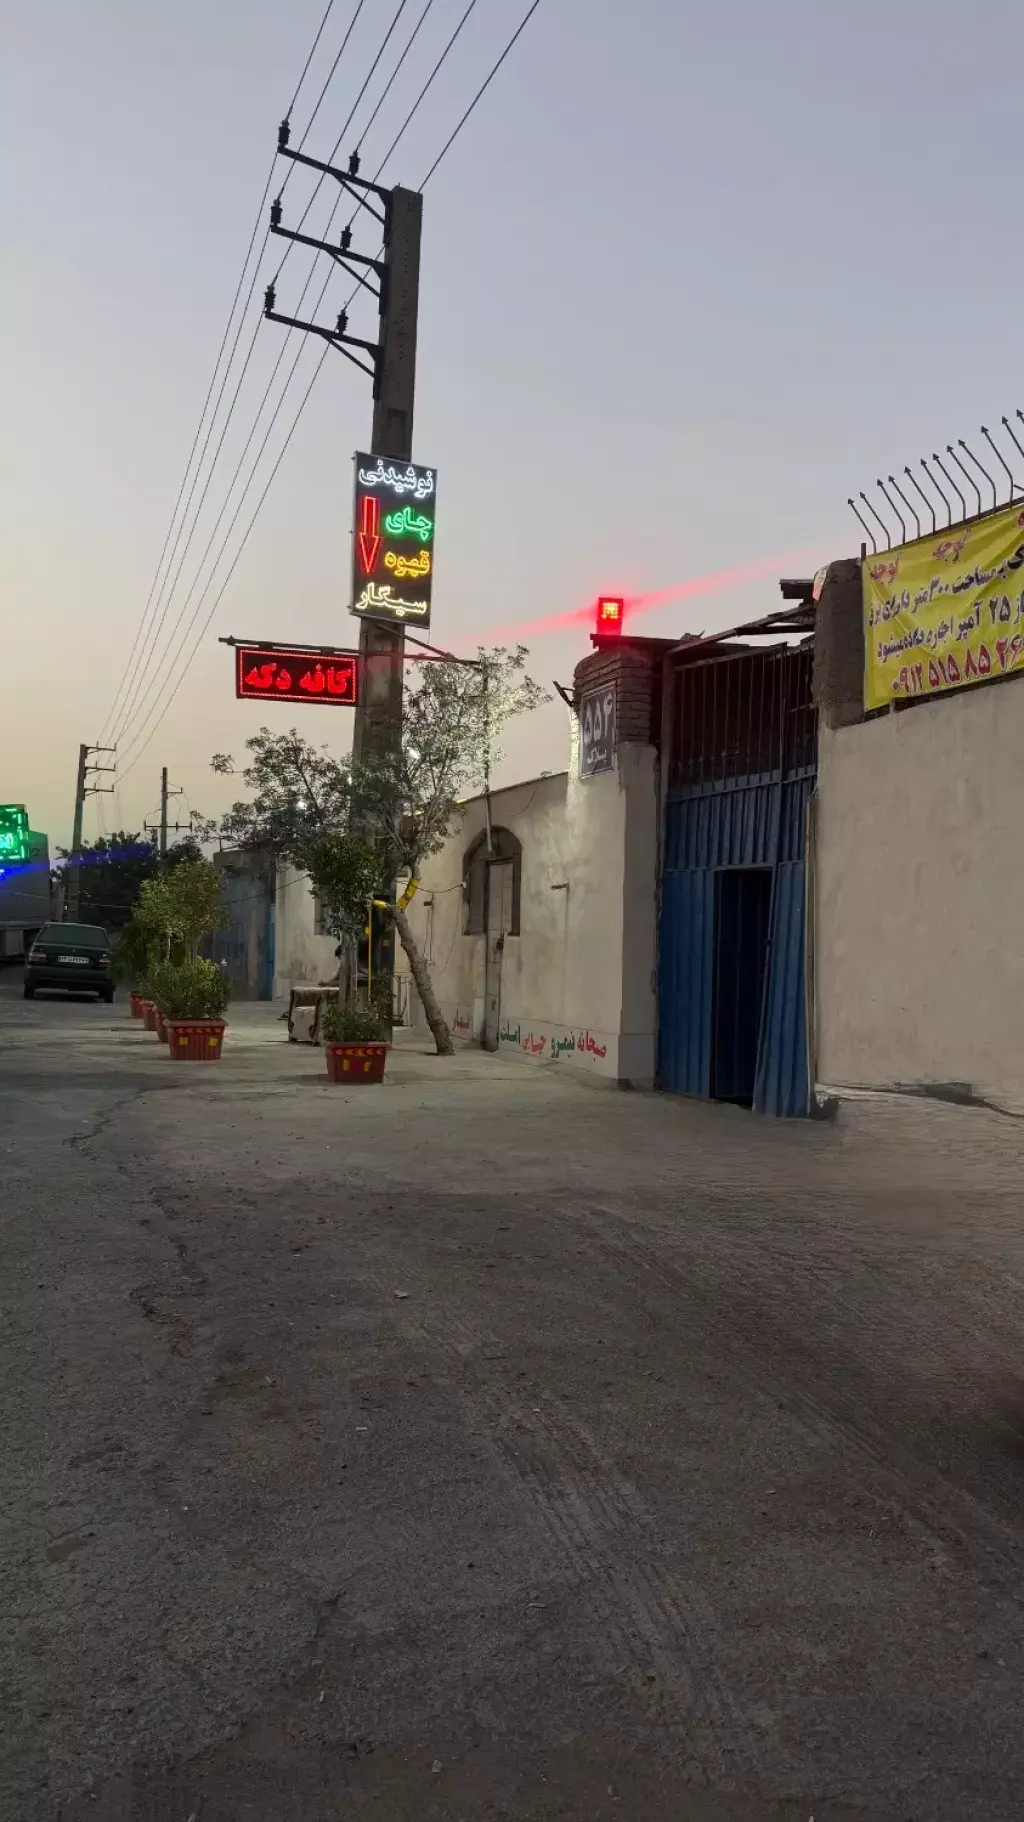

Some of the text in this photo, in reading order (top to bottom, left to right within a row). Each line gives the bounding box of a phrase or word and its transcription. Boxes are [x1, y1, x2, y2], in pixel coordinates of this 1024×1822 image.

[359, 459, 433, 498] نوشیدنی
[385, 507, 432, 541] چای
[384, 550, 430, 577] قهوه
[952, 564, 997, 594] مساحت
[356, 582, 427, 616] سیگار
[988, 594, 1011, 624] ۲۵
[955, 600, 981, 641] آمپر
[965, 643, 991, 677] ۸۵
[299, 663, 352, 693] کافه
